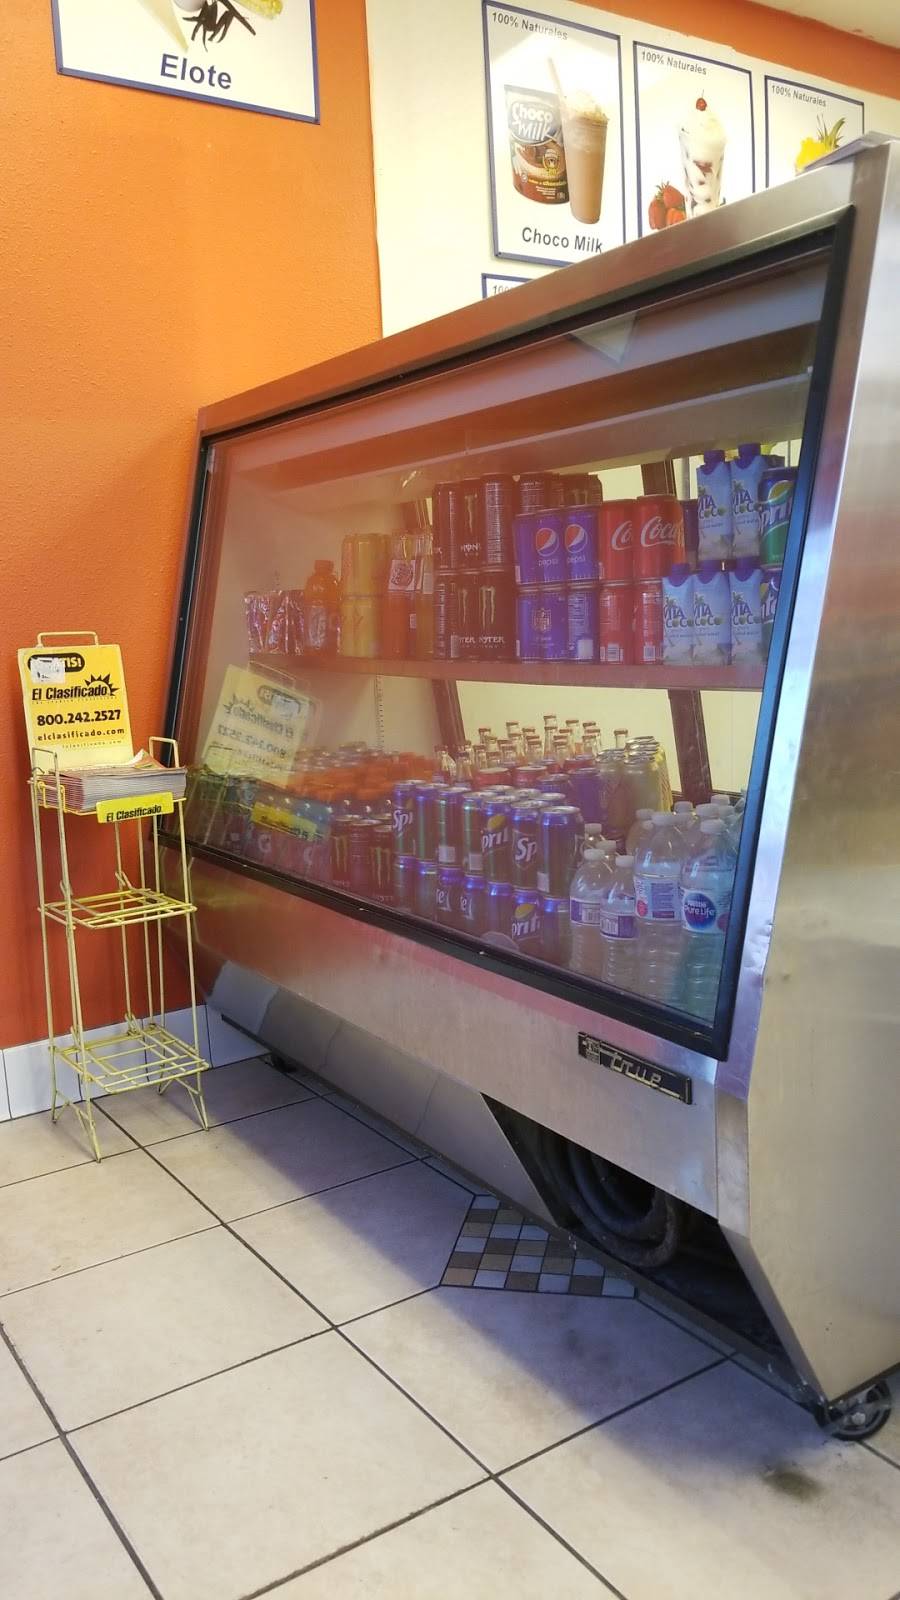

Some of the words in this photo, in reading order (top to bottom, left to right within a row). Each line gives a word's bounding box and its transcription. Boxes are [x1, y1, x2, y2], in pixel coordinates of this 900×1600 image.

[492, 12, 518, 28] 100%
[521, 19, 568, 40] Naturales
[160, 53, 232, 90] Elote
[642, 50, 665, 65] 100%
[667, 56, 707, 75] Naturales
[772, 85, 791, 98] 100%
[793, 90, 826, 107] Naturales
[511, 102, 553, 124] Choco
[511, 119, 552, 141] Milk
[522, 227, 569, 248] Choco
[574, 235, 603, 253] Milk
[611, 520, 633, 550] Co
[32, 688, 42, 700] El
[46, 684, 107, 700] Clasificado
[37, 709, 121, 726] 800.242.2527
[38, 728, 125, 740] elclasificado.com
[106, 812, 114, 822] El
[116, 804, 162, 820] Clasificado
[606, 1049, 662, 1088] true
